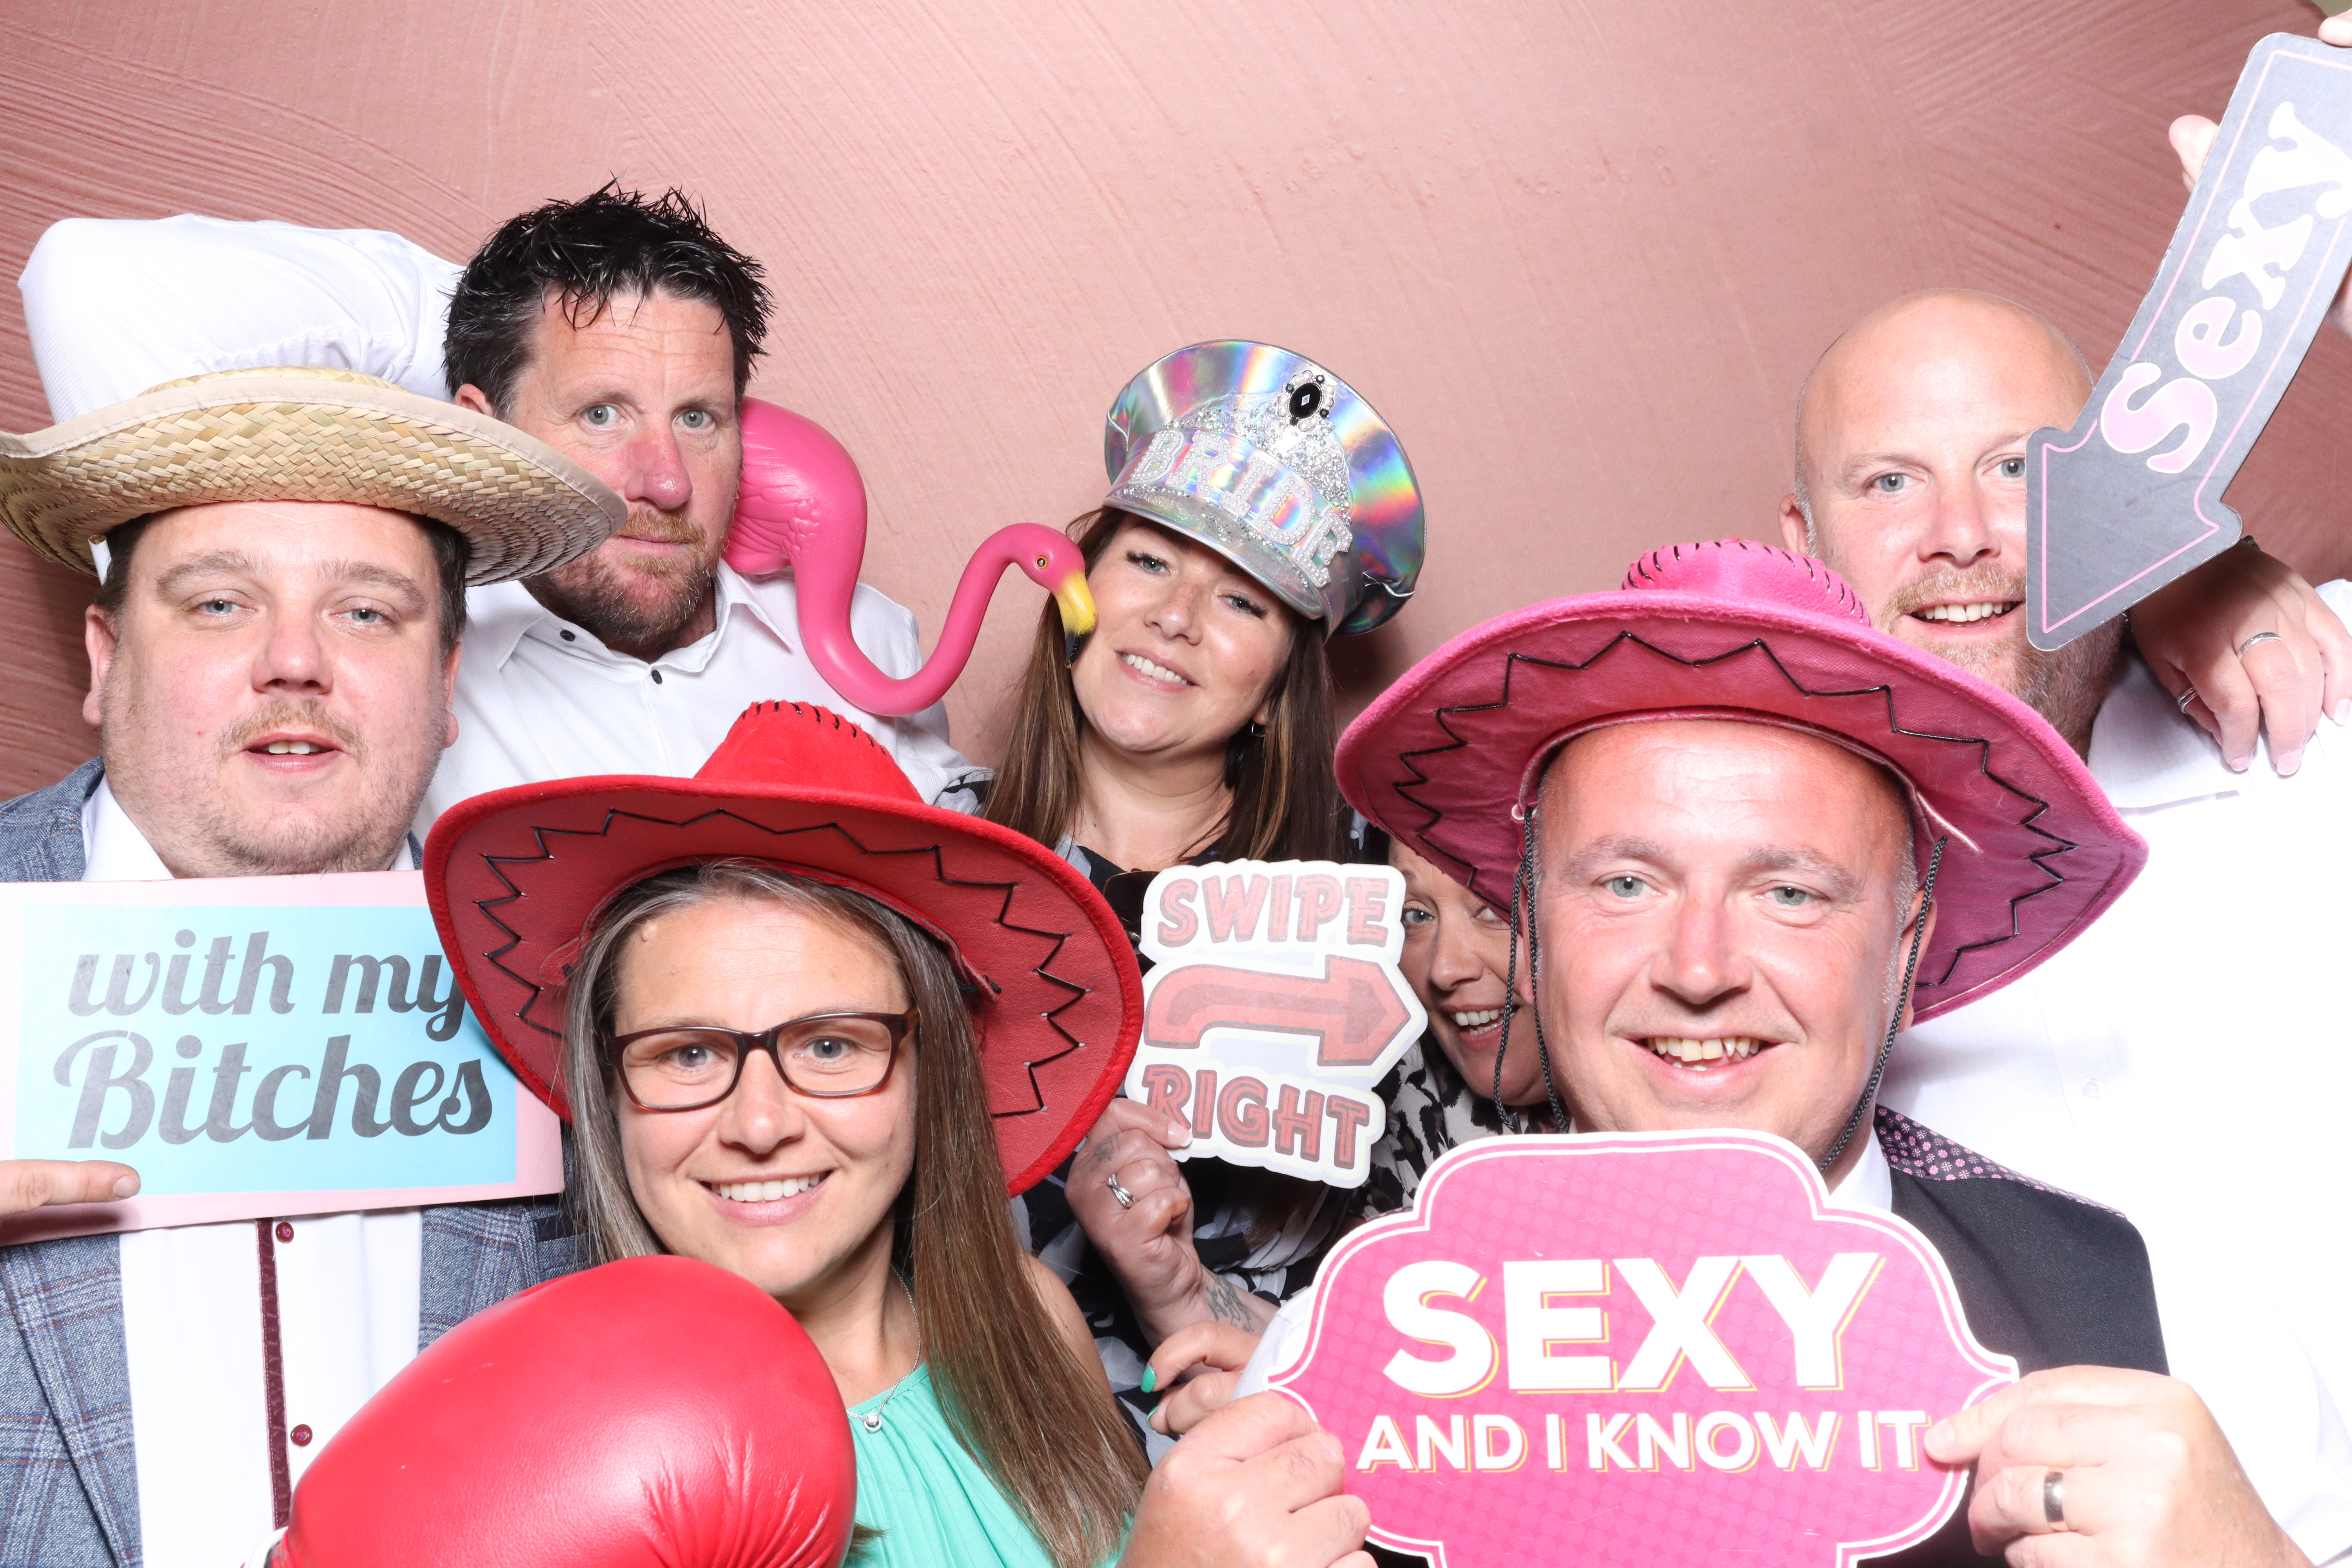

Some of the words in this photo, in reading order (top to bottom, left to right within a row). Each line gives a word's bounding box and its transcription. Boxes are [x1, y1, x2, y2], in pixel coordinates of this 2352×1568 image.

[2100, 100, 2352, 474] Sexy
[1128, 429, 1353, 588] BRIDE
[1157, 873, 1389, 947] SWIPE
[67, 929, 295, 1016] with
[321, 954, 467, 1041] my
[53, 1030, 492, 1149] Bitches
[1141, 1063, 1370, 1170] RIGHT
[1382, 1252, 1886, 1399] SEXY
[1357, 1413, 1527, 1473] AND
[1546, 1413, 1567, 1472] I
[1587, 1410, 1842, 1473] KNOW
[1857, 1410, 1932, 1472] IT
